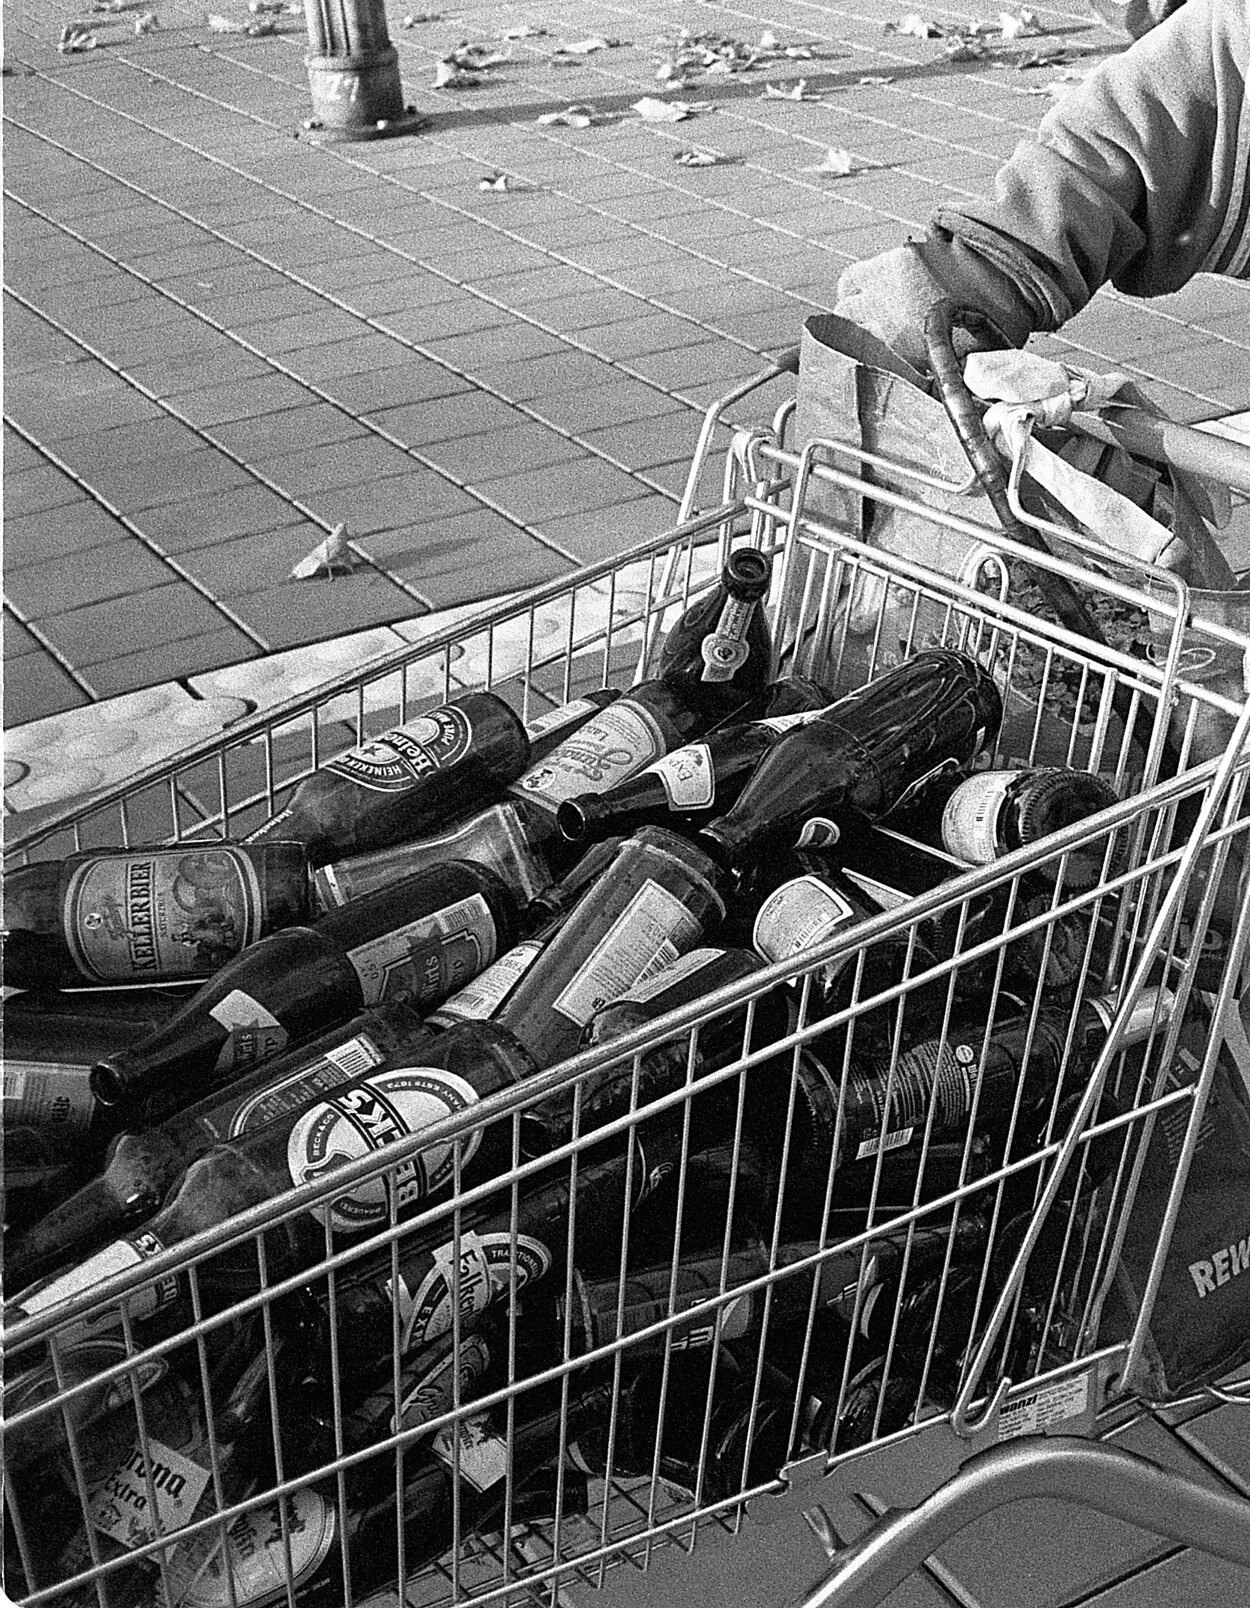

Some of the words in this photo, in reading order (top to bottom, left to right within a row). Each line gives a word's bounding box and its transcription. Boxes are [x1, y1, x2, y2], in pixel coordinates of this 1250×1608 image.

[440, 723, 457, 746] PURE
[130, 861, 156, 971] KELLERBIER
[998, 1394, 1038, 1415] wanzl
[105, 1466, 148, 1512] Extra
